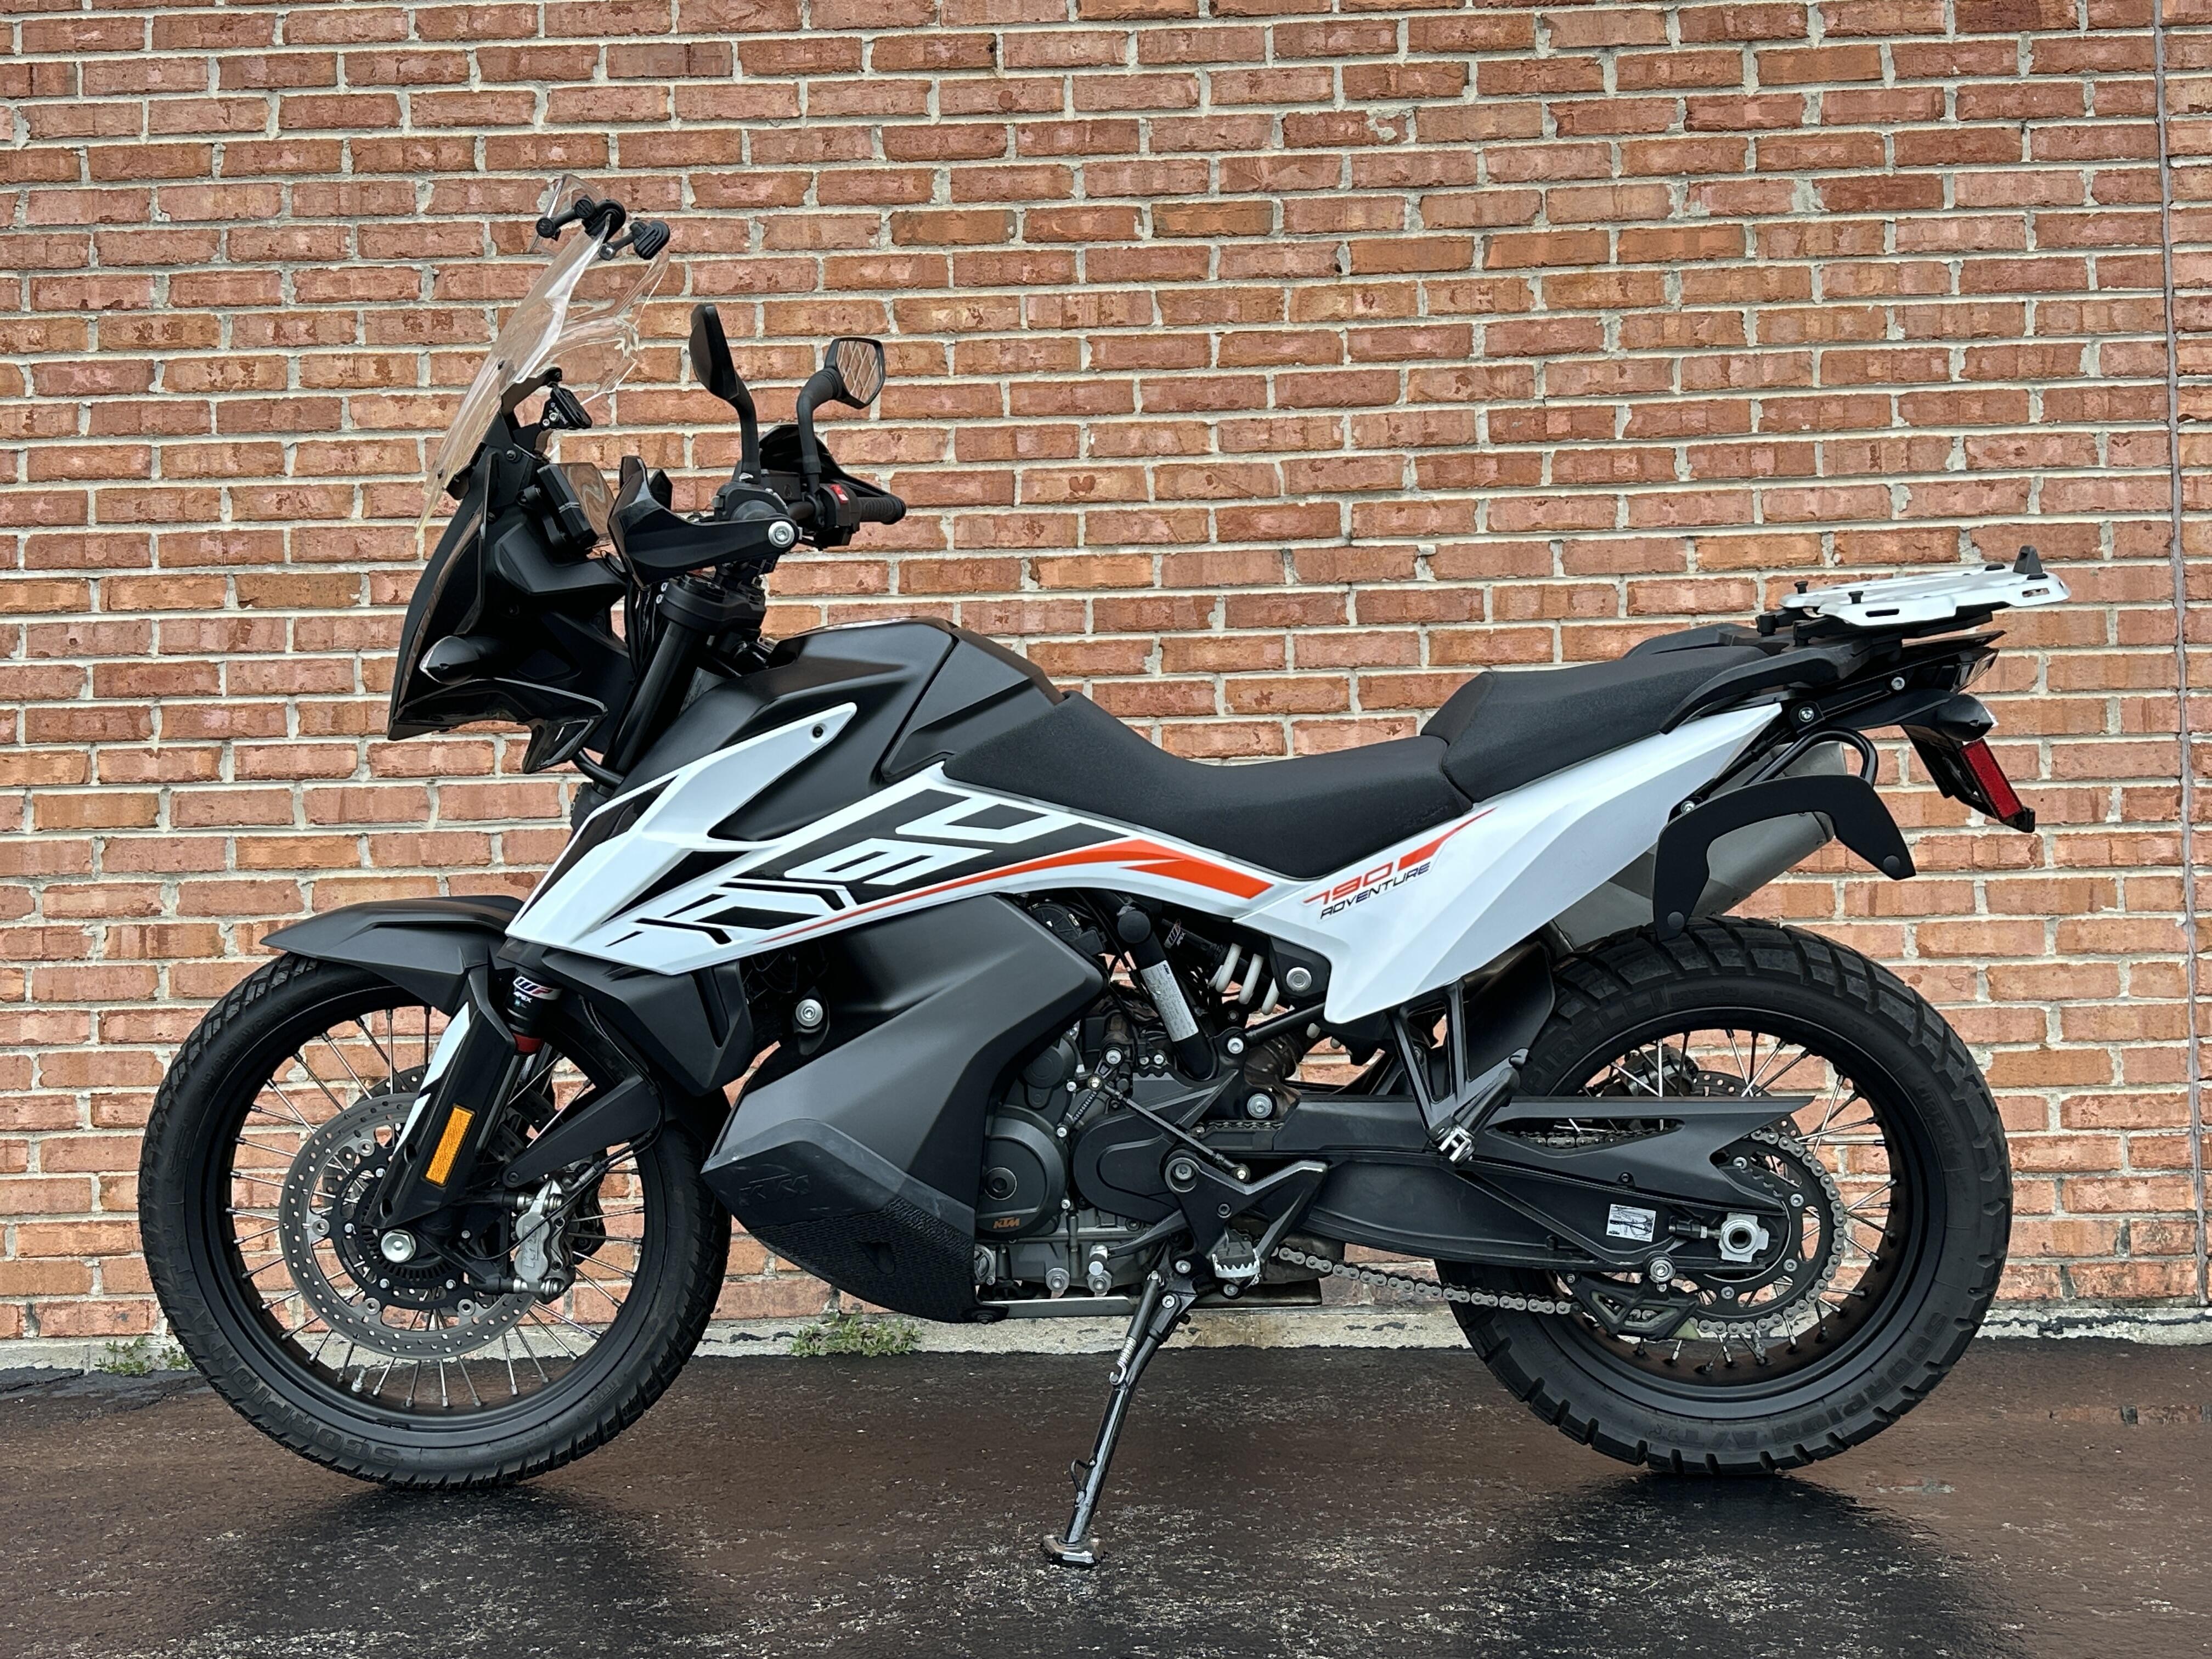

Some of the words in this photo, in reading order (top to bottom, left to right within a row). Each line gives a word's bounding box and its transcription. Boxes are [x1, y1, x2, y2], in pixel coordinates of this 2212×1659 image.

[1303, 861, 1393, 905] 790
[1320, 861, 1431, 919] ADVENTURE
[993, 1216, 1020, 1229] KTM
[1771, 1311, 1949, 1444] SCORPION
[217, 1348, 402, 1467] SCORPION
